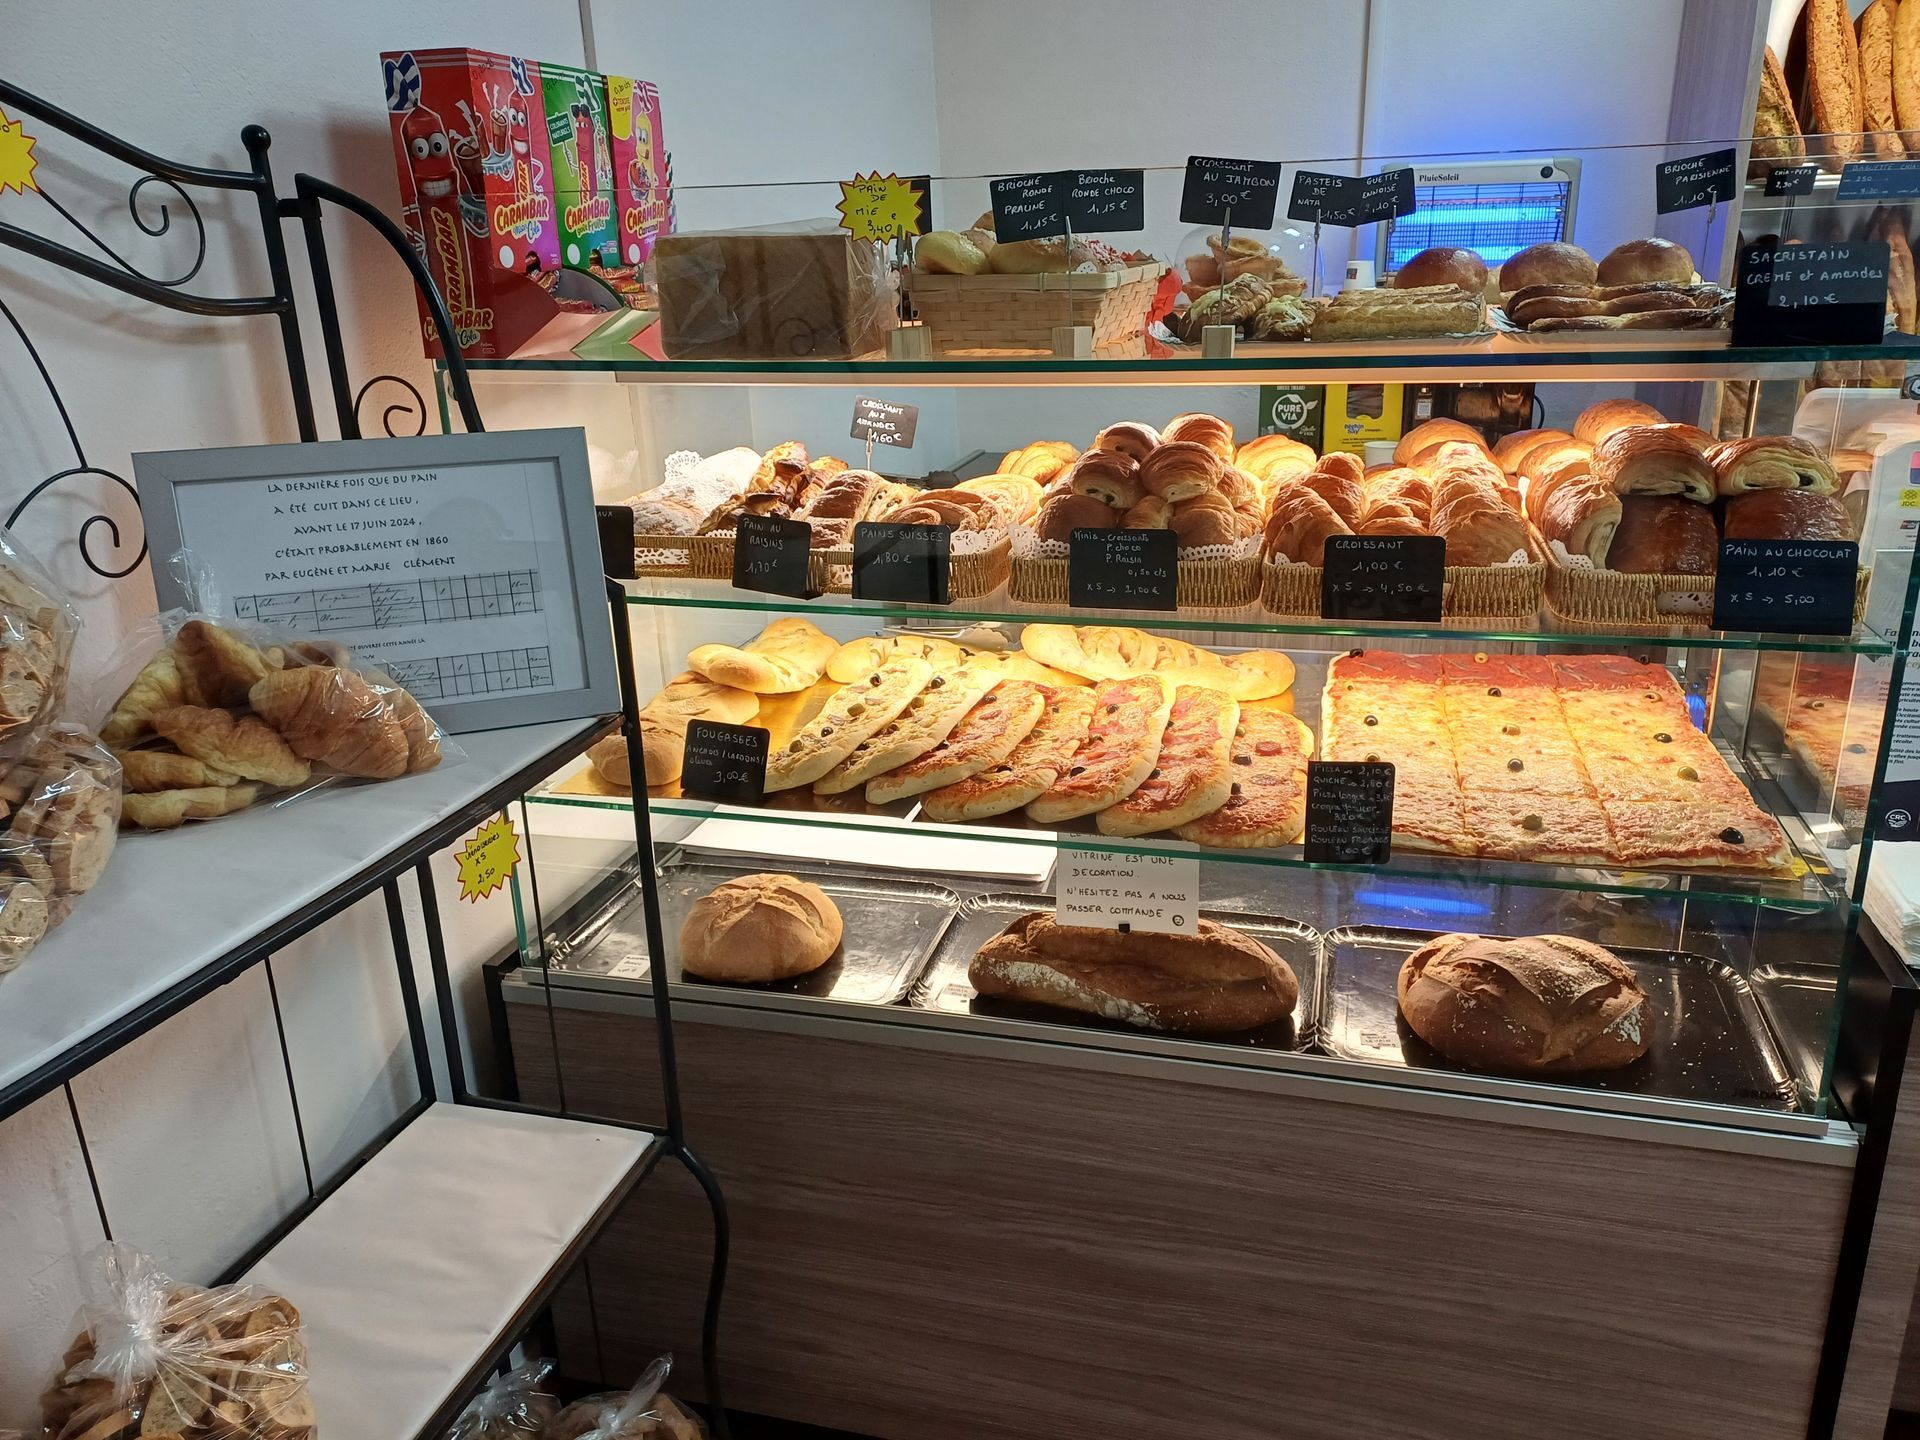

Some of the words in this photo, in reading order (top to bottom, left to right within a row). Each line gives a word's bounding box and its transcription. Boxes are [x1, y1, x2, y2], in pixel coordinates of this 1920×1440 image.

[1664, 158, 1706, 174] BRIOCHE
[1203, 171, 1219, 182] AU
[1225, 174, 1275, 187] JAMBON
[1298, 175, 1343, 188] PASTEIS
[1366, 171, 1400, 185] GUETTE
[1419, 173, 1459, 182] PluieSoleil
[1675, 164, 1731, 185] PARISIENNE
[858, 184, 887, 193] PAIN
[998, 176, 1042, 192] BRIOCHE
[1022, 185, 1053, 198] RONDE
[1312, 187, 1327, 196] DE
[1362, 184, 1397, 199] ENNOISE
[870, 194, 888, 202] DE
[1071, 188, 1100, 198] RONDE
[1104, 186, 1136, 196] CHOCO
[1297, 198, 1321, 206] NATA
[496, 197, 548, 232] CARAMBAR
[565, 200, 610, 230] CARAMBAR
[627, 202, 664, 231] CARAMBAR
[855, 205, 879, 216] MIE
[867, 219, 892, 236] 3,40
[431, 208, 463, 313] ARAMBAR
[1749, 250, 1851, 264] SACRISTAIN
[1746, 271, 1793, 286] CREME
[1799, 270, 1814, 281] et
[424, 311, 492, 340] CAMBAR
[861, 399, 904, 415] CROISSANT
[868, 410, 885, 419] AUX
[1278, 404, 1302, 412] PURE
[856, 417, 896, 430] AMANDES
[1281, 412, 1298, 420] VIA
[267, 484, 283, 493] LA
[286, 479, 340, 492] DERNIÈRE
[343, 478, 365, 488] FOIS
[368, 476, 390, 486] QUE
[393, 475, 408, 484] DU
[411, 473, 438, 483] PAIN
[274, 506, 284, 514] A
[290, 503, 307, 514] ÉTÉ
[314, 502, 338, 511] CUIT
[342, 499, 370, 509] DANS
[374, 498, 387, 507] CE
[294, 524, 333, 535] AVANT
[336, 522, 348, 532] LE
[350, 521, 360, 530] 17
[362, 519, 387, 530] JUIN
[742, 517, 764, 532] PAIN
[769, 523, 782, 533] AU
[749, 533, 784, 550] RAISINS
[861, 527, 894, 539] PAINS
[899, 528, 944, 542] SUISSES
[275, 547, 315, 558] C'ÉTAIT
[318, 540, 403, 555] PROBABLEMENT
[406, 538, 419, 547] EN
[425, 536, 449, 545] 1860
[1335, 538, 1404, 549] CROISSANT
[1725, 543, 1757, 556] PAIN
[1765, 549, 1783, 557] AU
[1787, 548, 1852, 559] CHOCOLAT
[265, 571, 290, 581] PAR
[293, 566, 334, 578] EUGÈNE
[337, 566, 348, 575] ET
[352, 562, 391, 573] MARIE
[403, 556, 456, 568] CLÉMENT
[1352, 561, 1388, 573] 1,00
[696, 727, 757, 748] FOUGASSES
[1313, 776, 1346, 785] QUICHE
[1310, 824, 1349, 833] ROULEAU
[1072, 851, 1114, 861] VITRINE
[1125, 854, 1144, 863] EST
[1151, 856, 1174, 866] UNE
[1072, 868, 1134, 878] DECORATION
[1066, 887, 1119, 897] N'HESITEZ
[1125, 891, 1142, 899] PAS
[1066, 904, 1103, 913] PASSER
[1110, 906, 1164, 918] COMMANDE
